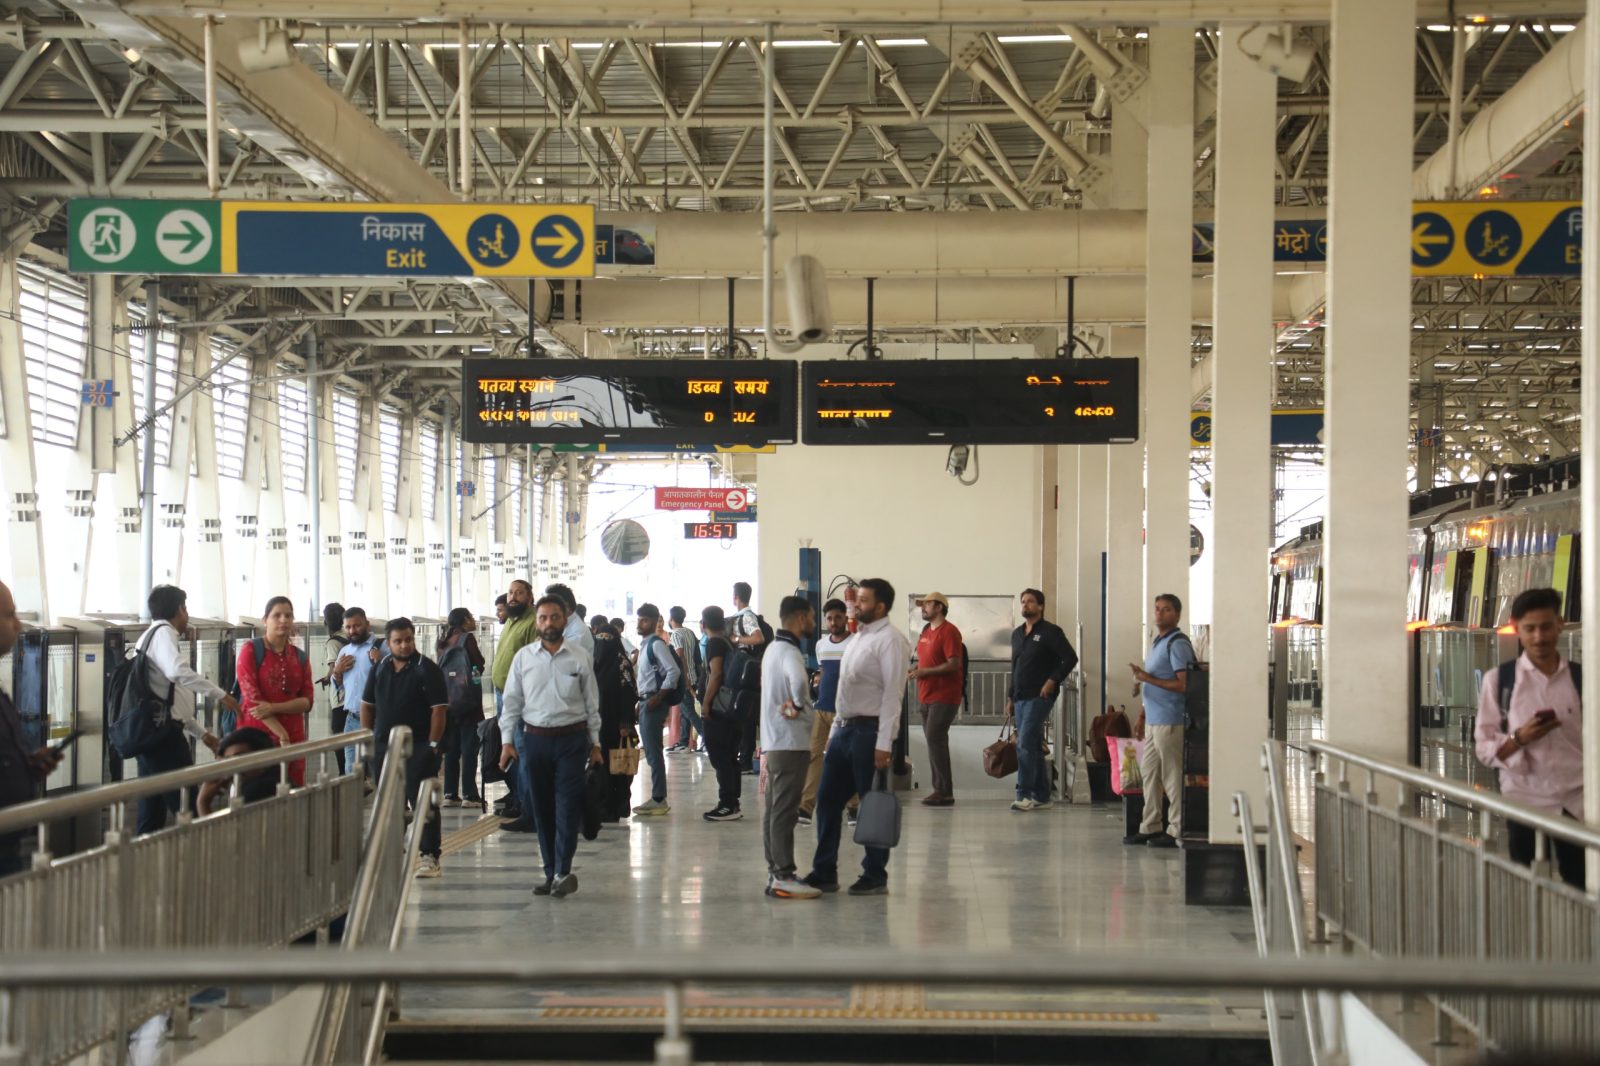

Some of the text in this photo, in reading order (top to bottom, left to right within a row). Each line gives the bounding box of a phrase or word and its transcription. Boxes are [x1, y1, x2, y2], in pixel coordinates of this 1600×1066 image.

[360, 215, 427, 241] निकास
[386, 247, 427, 268] Exit
[660, 500, 724, 508] Emergency Panel
[694, 524, 733, 538] 16:57
